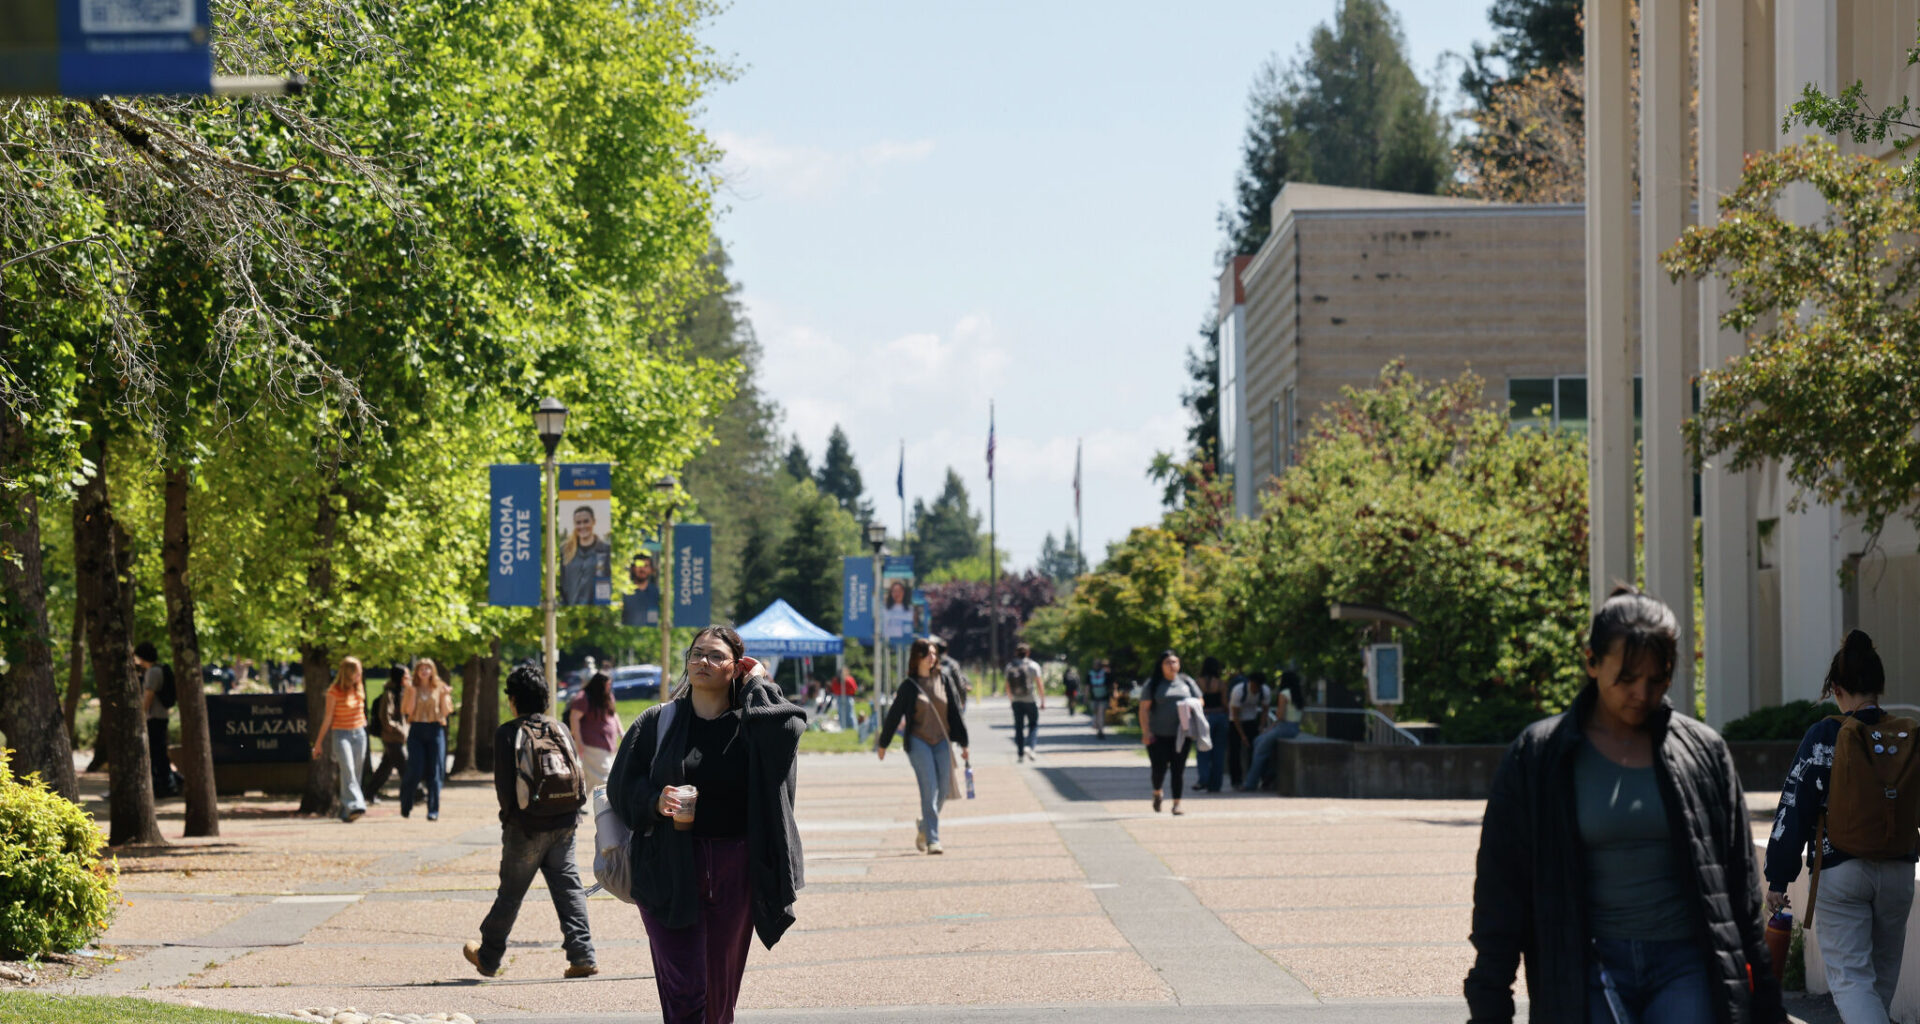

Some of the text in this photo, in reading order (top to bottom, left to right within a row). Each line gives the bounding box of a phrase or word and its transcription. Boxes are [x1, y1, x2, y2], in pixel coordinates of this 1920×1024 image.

[499, 495, 514, 576] SONOMA
[516, 509, 531, 561] STATE
[680, 545, 692, 605] SONOMA
[692, 556, 704, 595] STATE
[744, 640, 786, 652] ONOMA
[251, 705, 283, 715] Ruben
[225, 719, 308, 735] SALAZAR
[256, 739, 279, 749] Hall
